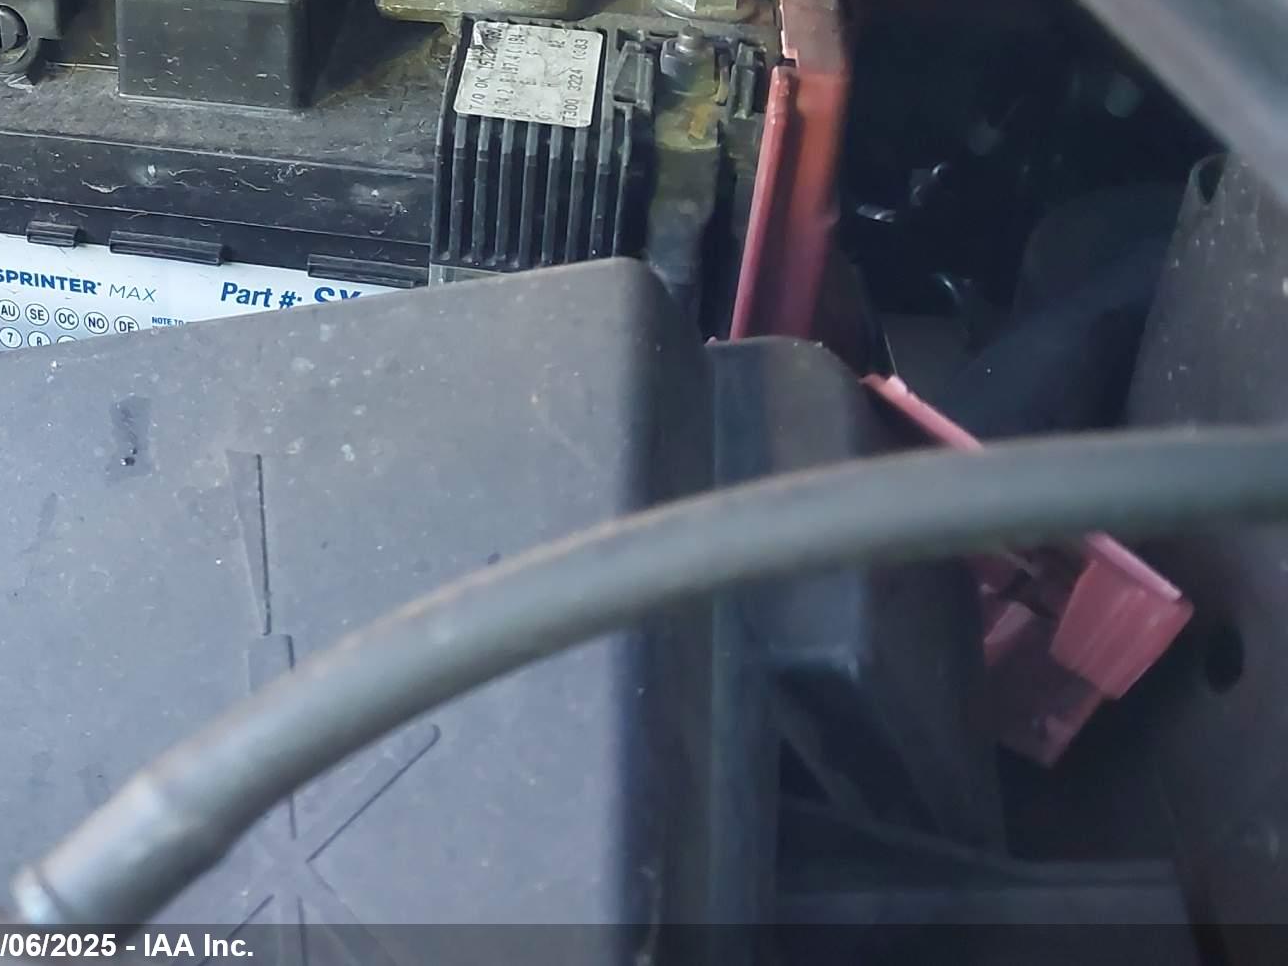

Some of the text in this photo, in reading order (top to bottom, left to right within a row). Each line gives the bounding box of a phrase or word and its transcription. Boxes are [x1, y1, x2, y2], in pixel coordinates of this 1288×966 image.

[109, 284, 157, 302] MAX
[221, 281, 273, 308] Part
[1, 304, 16, 316] AU
[29, 309, 45, 321] SE
[58, 313, 75, 325] OC
[88, 317, 105, 329] NO
[152, 317, 172, 326] NOTE
